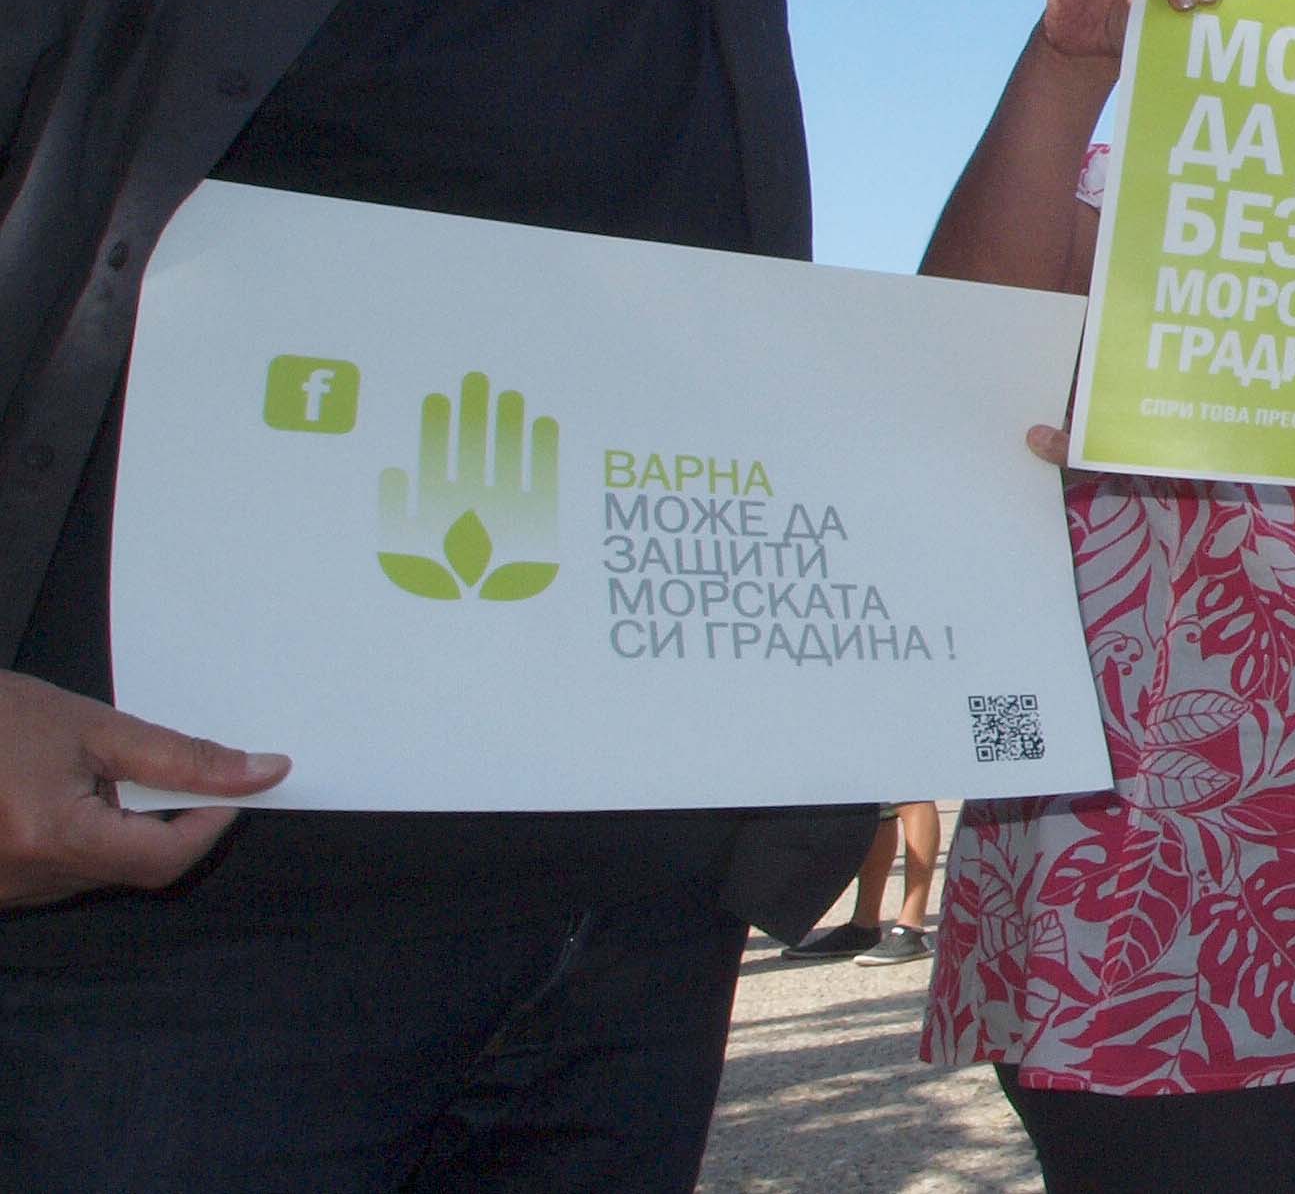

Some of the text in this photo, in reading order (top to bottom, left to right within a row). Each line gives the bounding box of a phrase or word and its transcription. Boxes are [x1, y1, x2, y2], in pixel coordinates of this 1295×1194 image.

[1167, 94, 1284, 183] ДА
[1140, 398, 1193, 419] СПРИ
[1200, 401, 1249, 424] ТОВА
[604, 449, 774, 497] ВАРНА
[604, 492, 848, 545] МОЖЕ ДА
[603, 534, 829, 583] ЗАЩИТИ
[608, 577, 890, 621] МОРСКАТА
[609, 619, 685, 659] СИ
[705, 621, 933, 667] ГРАДИНА
